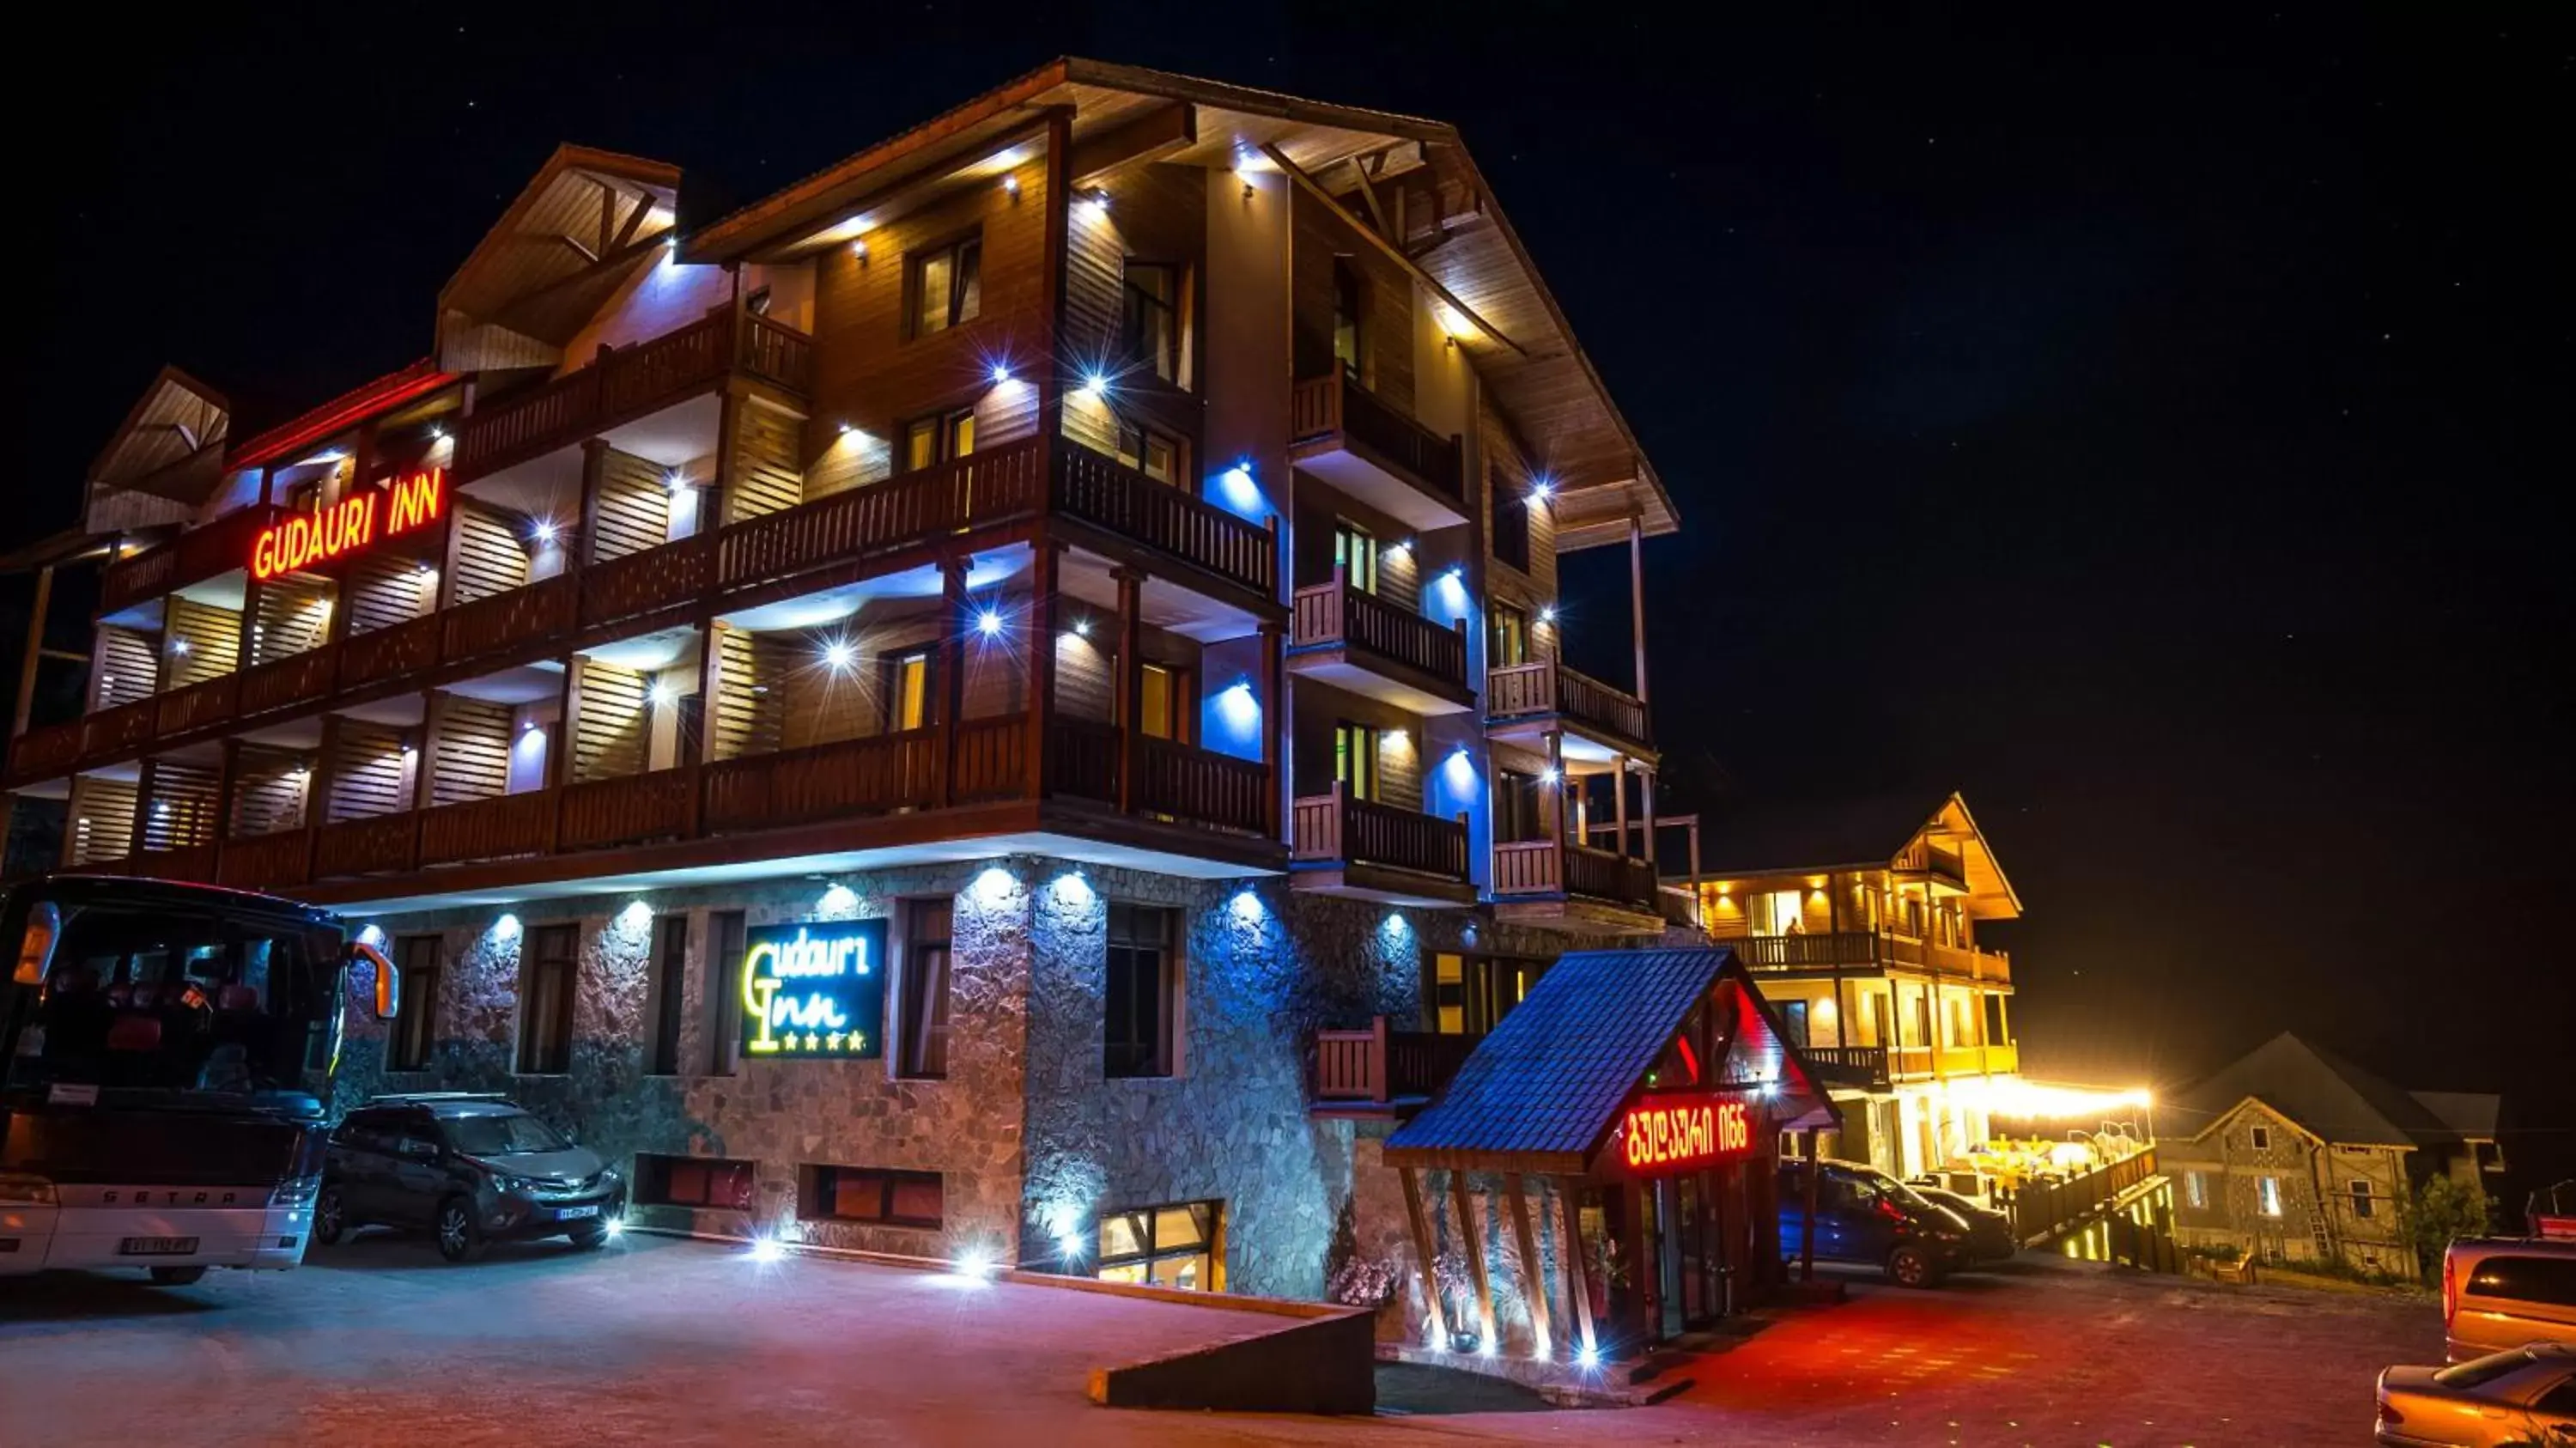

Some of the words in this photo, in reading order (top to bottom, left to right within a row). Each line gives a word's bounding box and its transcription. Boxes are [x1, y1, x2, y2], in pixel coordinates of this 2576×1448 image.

[254, 492, 375, 578] GUDAURI
[388, 466, 440, 535] INN
[744, 927, 870, 1019] Gudauri
[750, 978, 848, 1051] Inn
[1628, 1106, 1713, 1166] გუდაური
[1719, 1103, 1748, 1152] ინნ
